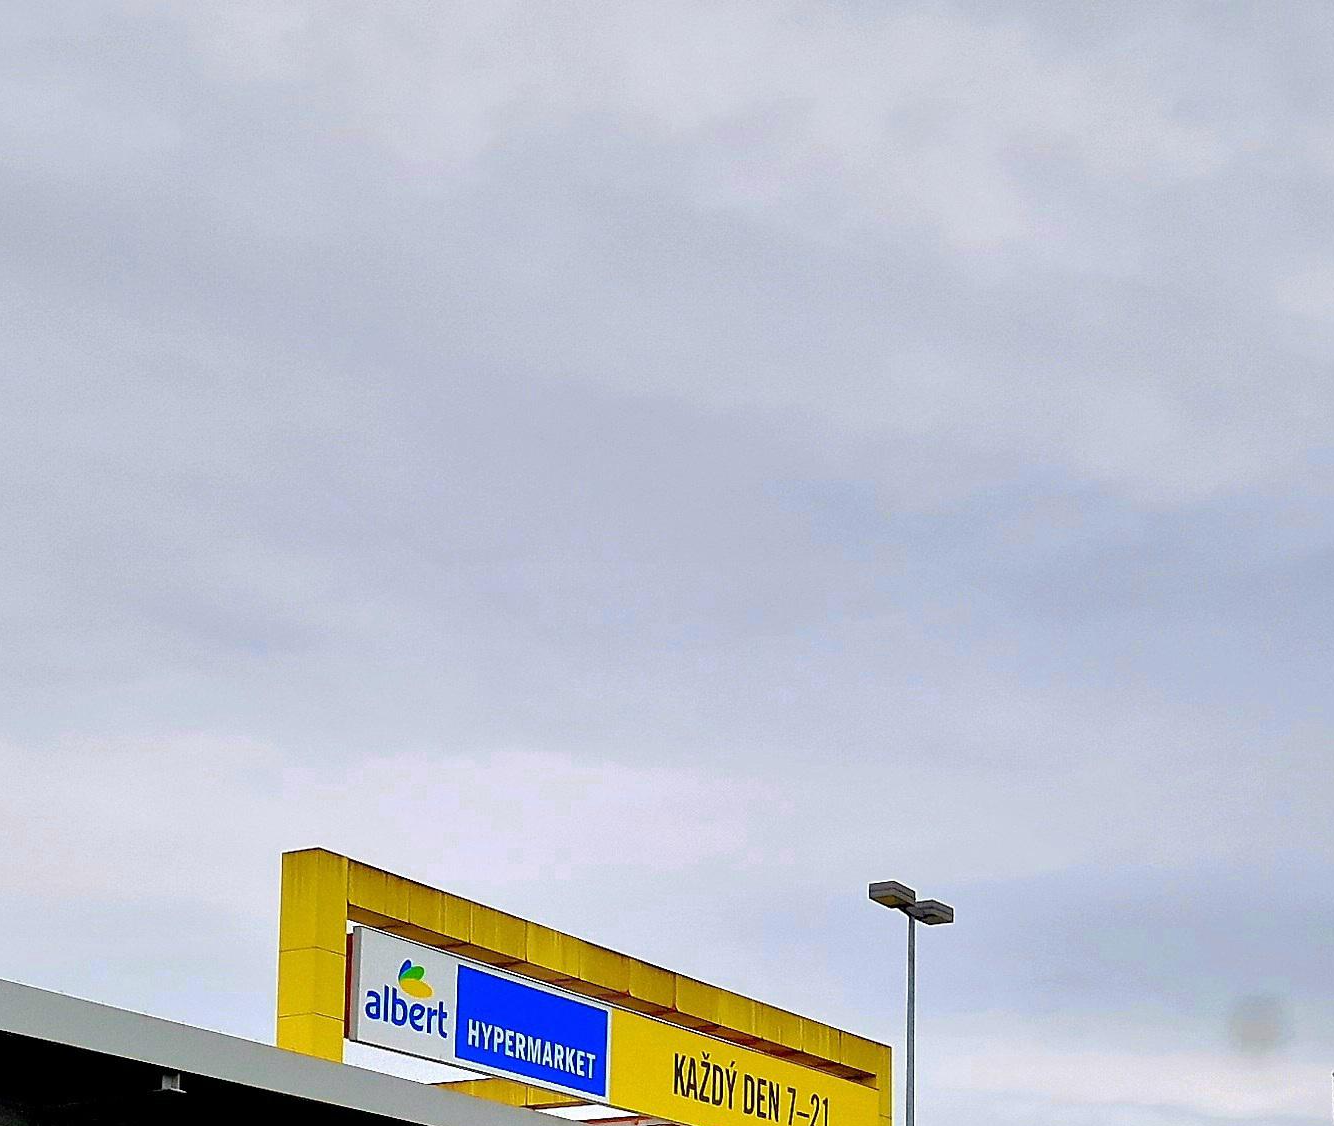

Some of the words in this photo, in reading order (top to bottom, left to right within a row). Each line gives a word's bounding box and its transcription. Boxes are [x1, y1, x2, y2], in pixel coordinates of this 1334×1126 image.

[365, 984, 448, 1038] albert
[468, 1019, 596, 1079] HYPERMARKET
[673, 1051, 737, 1110] KAŽDÝ
[743, 1074, 779, 1122] DEN
